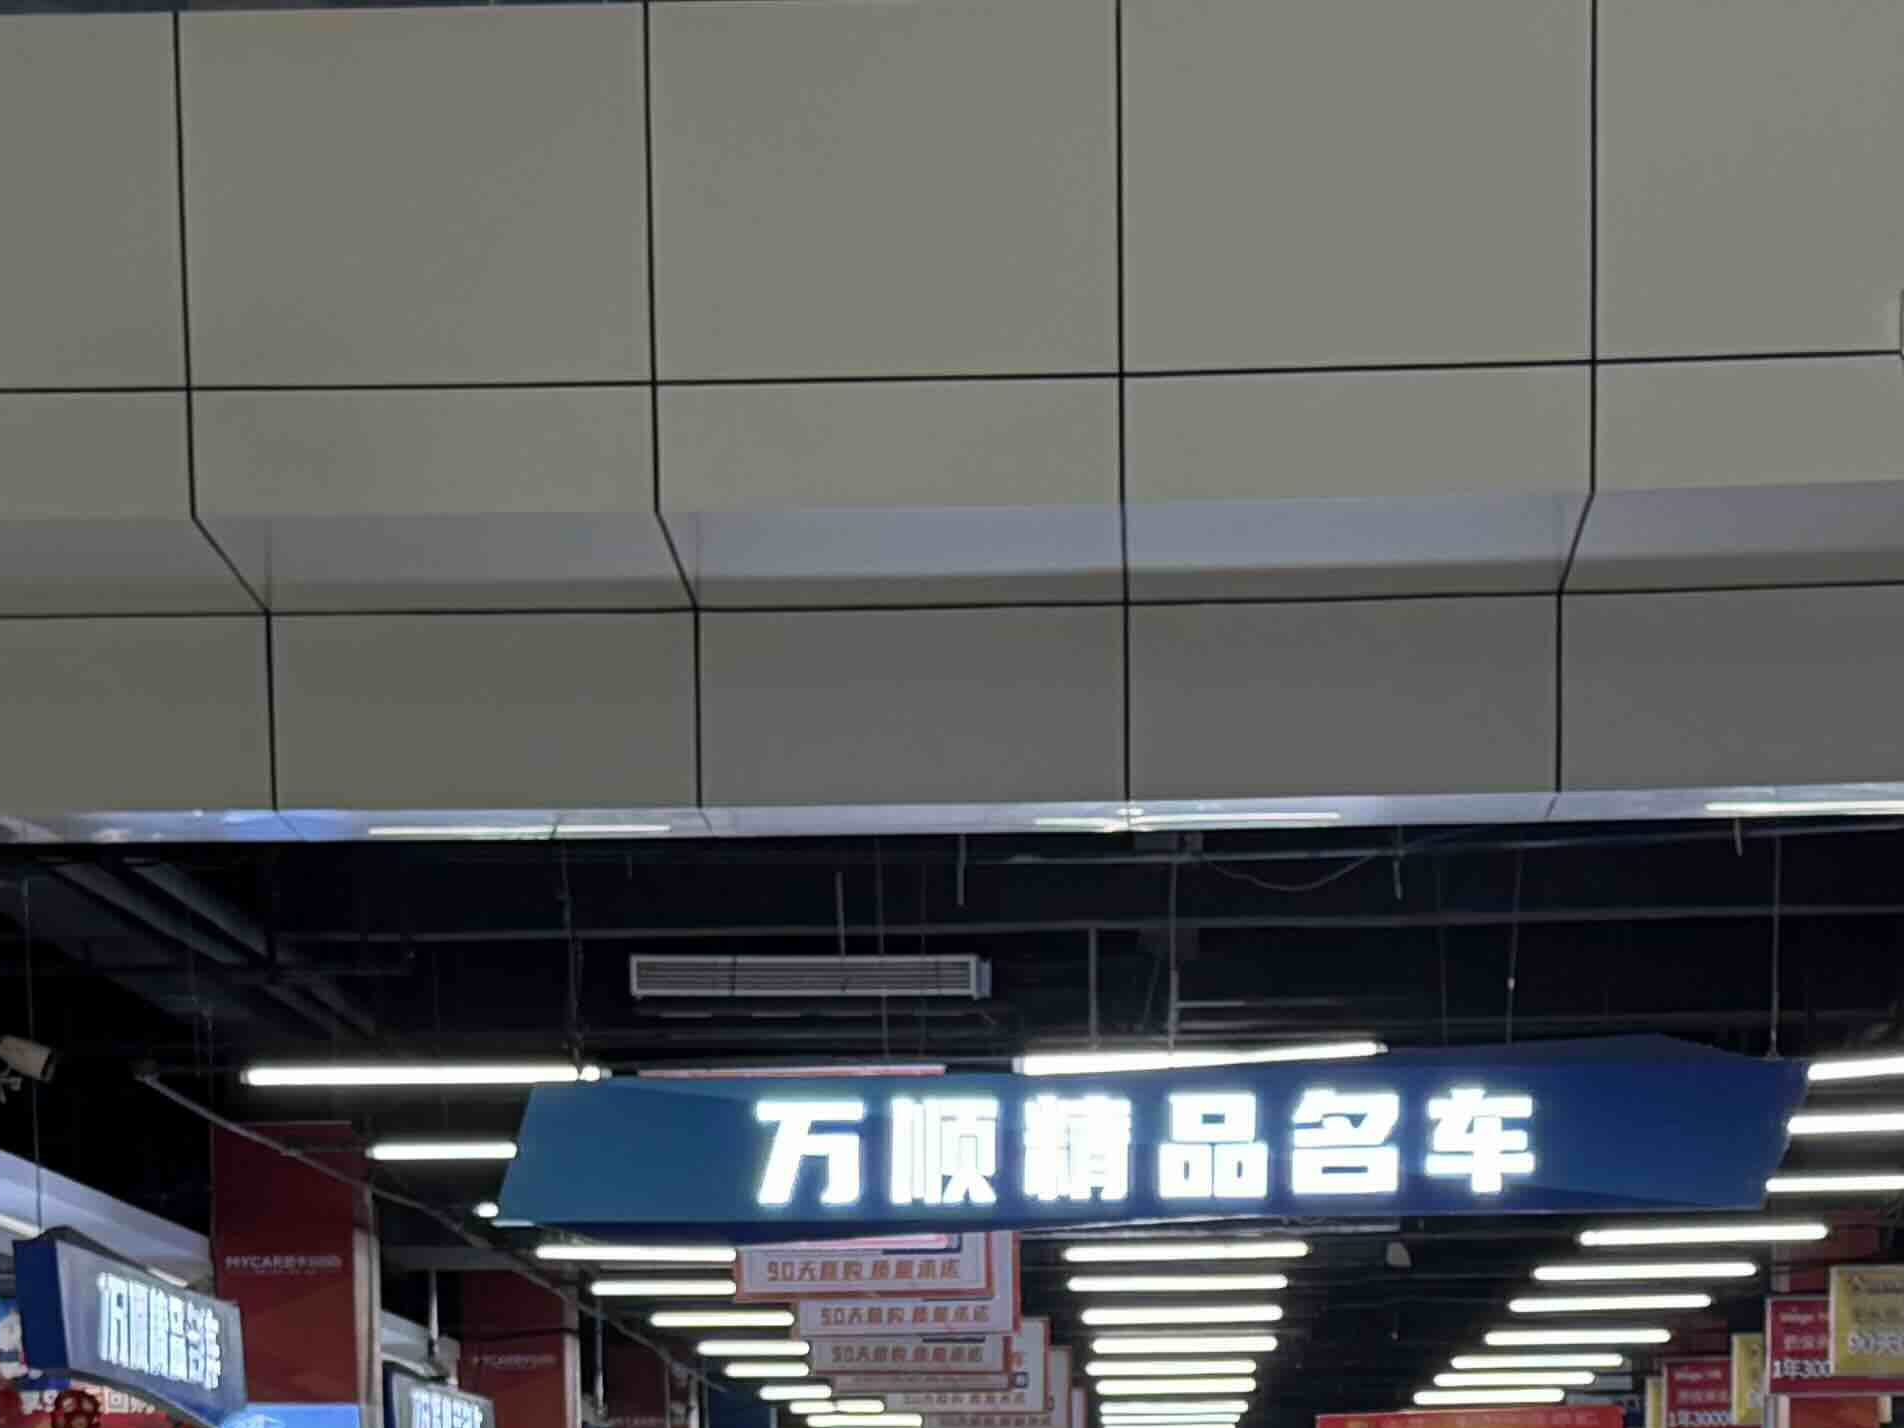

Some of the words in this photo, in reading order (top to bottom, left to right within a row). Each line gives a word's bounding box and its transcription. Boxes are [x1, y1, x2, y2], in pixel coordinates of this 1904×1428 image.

[754, 1088, 1537, 1205] 万顺精品名车
